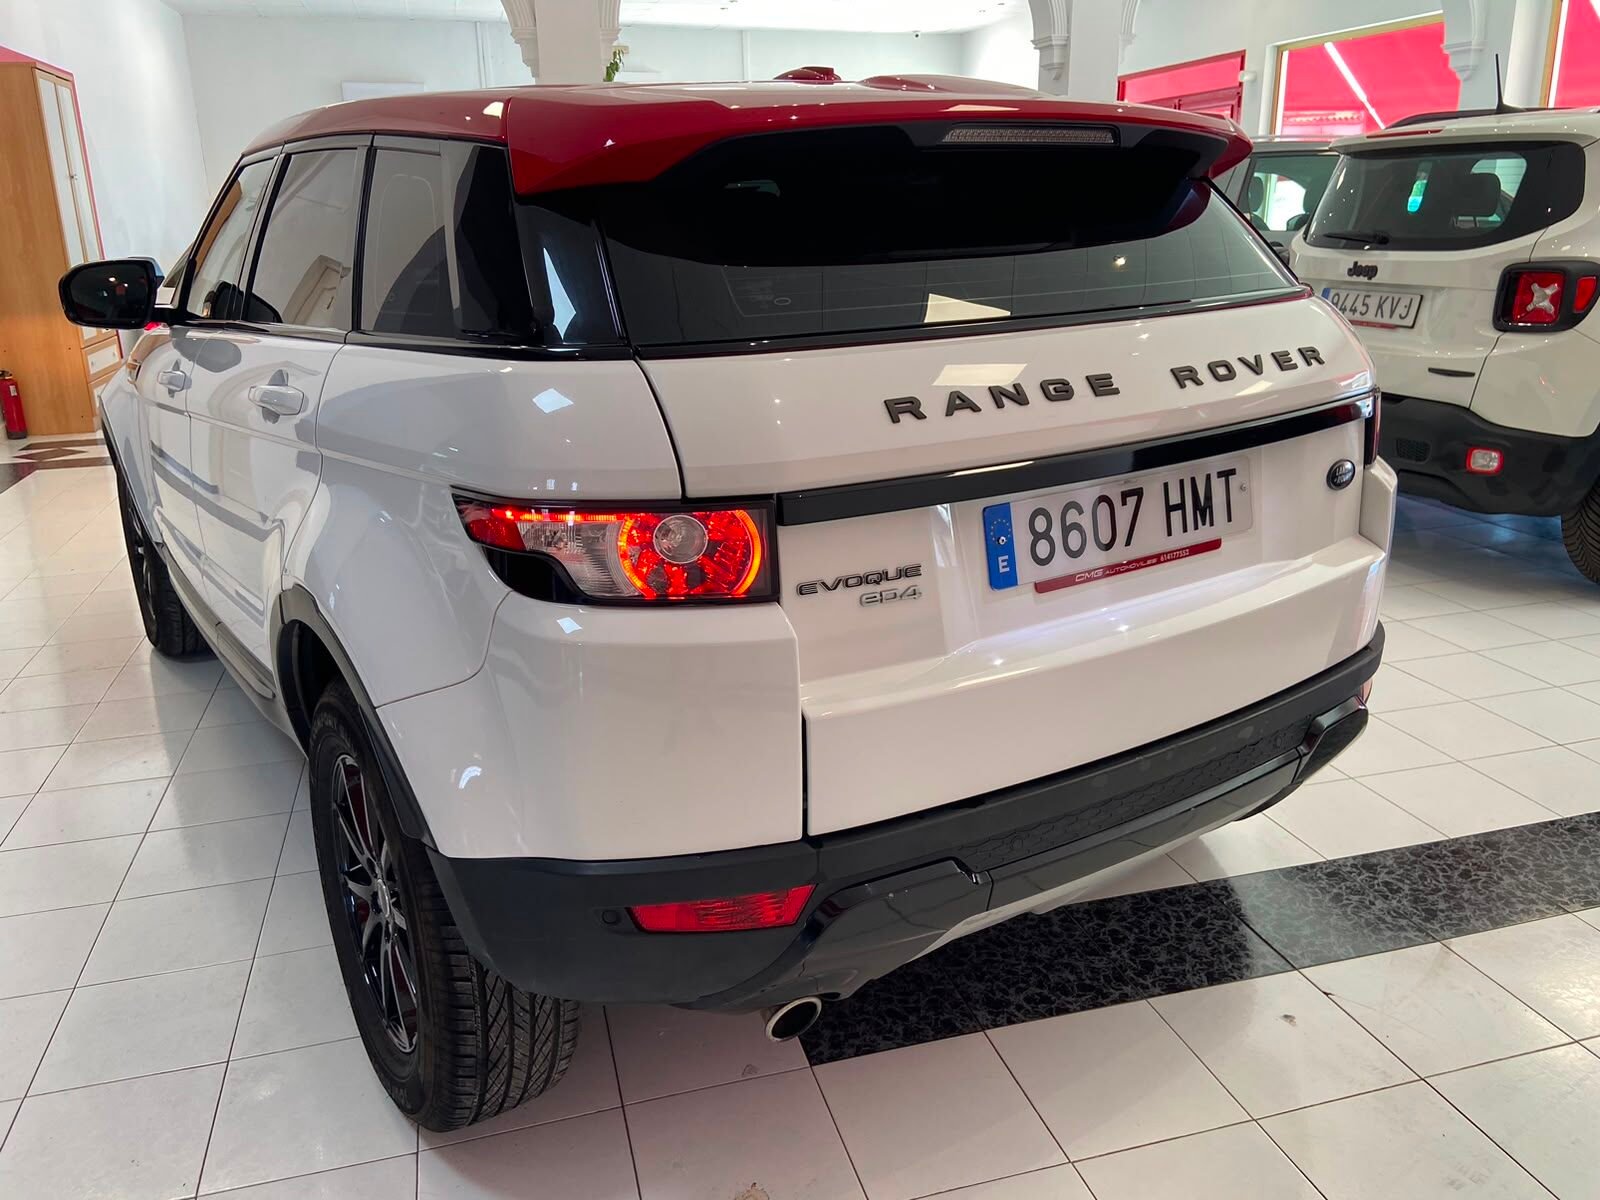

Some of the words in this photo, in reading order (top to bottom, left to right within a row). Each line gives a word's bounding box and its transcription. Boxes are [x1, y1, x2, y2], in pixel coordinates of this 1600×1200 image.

[1347, 261, 1378, 280] Jeep
[1331, 293, 1371, 316] 9445
[1374, 295, 1413, 320] KVJ
[884, 373, 1120, 424] RANGE
[1170, 346, 1325, 389] ROVER
[1028, 487, 1144, 567] 8607
[1163, 468, 1237, 537] HMT
[997, 555, 1010, 573] E
[1075, 568, 1104, 582] CMG
[797, 564, 922, 596] EVOQUE
